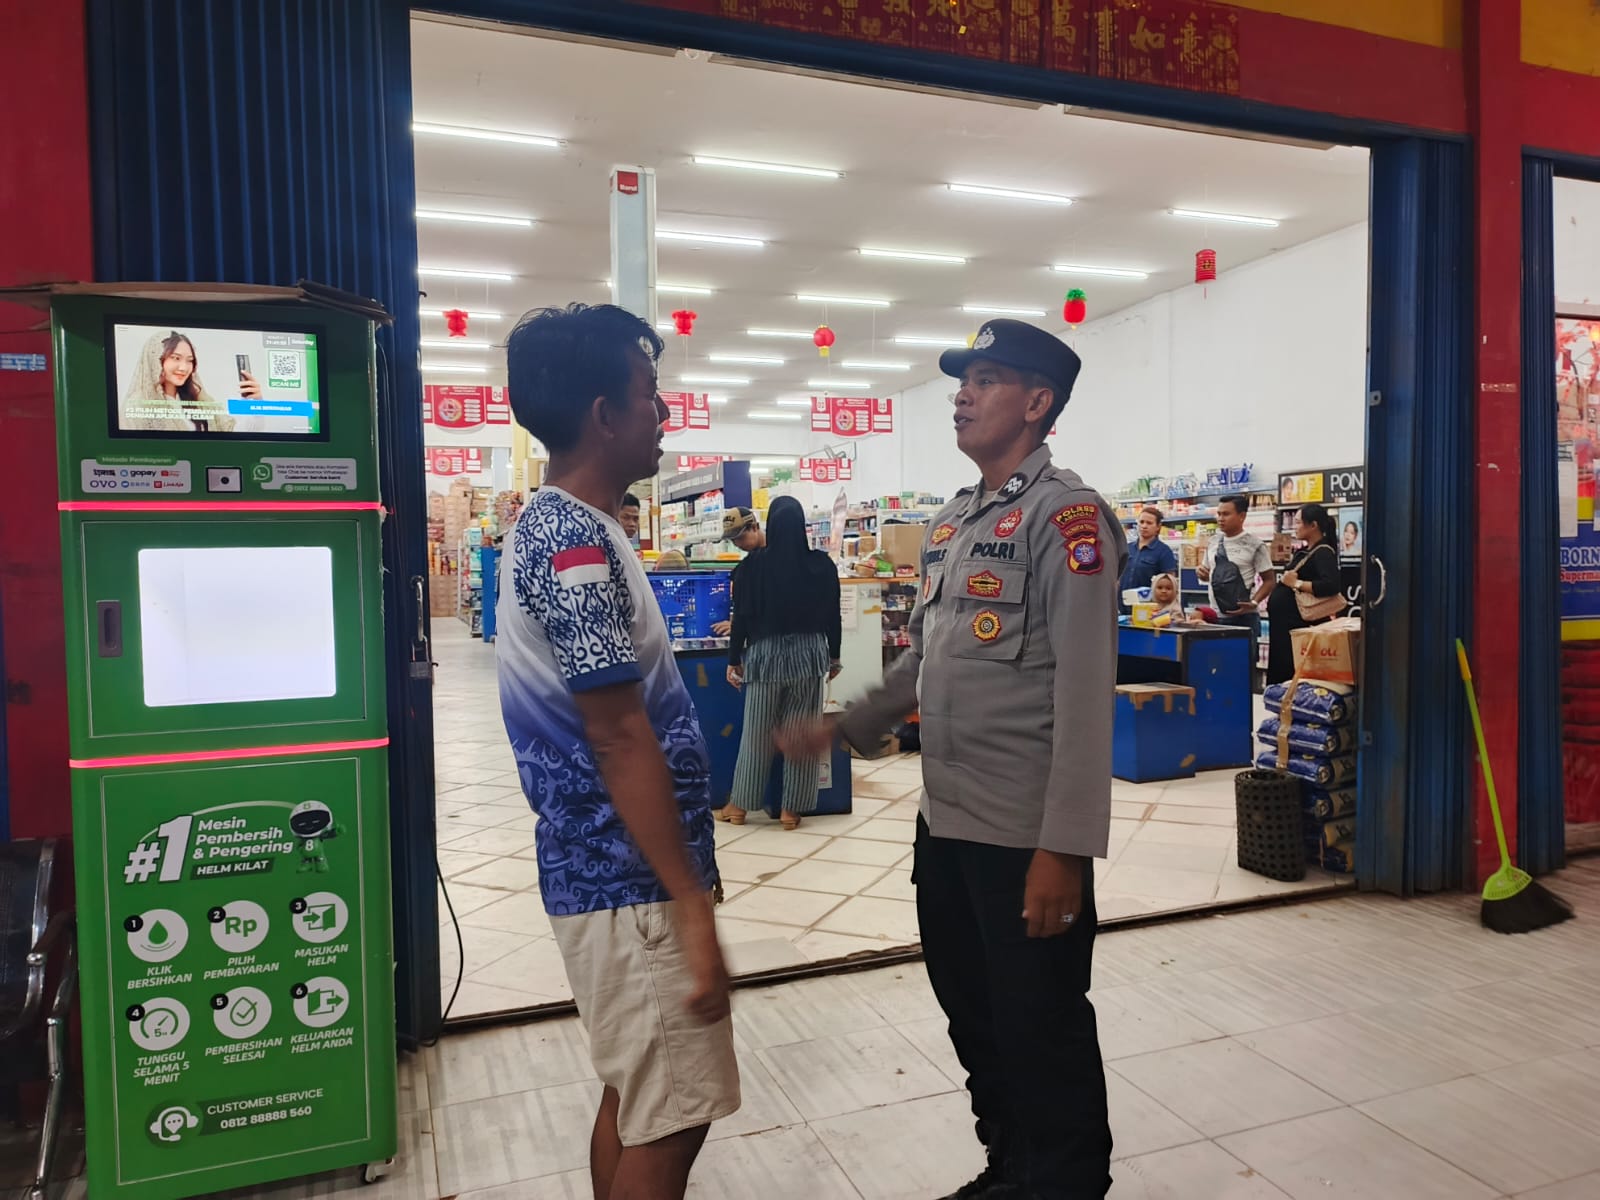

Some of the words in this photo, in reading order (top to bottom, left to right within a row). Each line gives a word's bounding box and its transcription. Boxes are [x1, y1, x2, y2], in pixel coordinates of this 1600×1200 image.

[90, 480, 117, 488] OVO
[970, 542, 1016, 559] POLRI
[198, 816, 246, 831] Mesin
[195, 827, 283, 845] Pembersih
[193, 848, 204, 859] &
[209, 840, 293, 858] Pengering
[197, 863, 232, 875] HELM
[234, 860, 269, 872] KILAT
[295, 902, 302, 910] 3
[213, 911, 221, 919] 2
[225, 916, 257, 937] Rp
[294, 944, 349, 958] MASUKAN
[227, 955, 256, 966] PILIH
[307, 955, 337, 967] HELM
[147, 965, 172, 976] KLIK
[203, 962, 280, 980] PEMBAYARAN
[127, 973, 192, 990] BERSIHKAN
[296, 987, 303, 996] 6
[216, 998, 224, 1006] 5
[132, 1009, 140, 1017] 4
[290, 1027, 354, 1044] KELUARKAN
[205, 1037, 283, 1056] PEMBERSIHAN
[291, 1041, 320, 1054] HELM
[322, 1037, 353, 1050] ANDA
[137, 1051, 185, 1067] TUNGGU
[223, 1049, 266, 1064] SELESAI
[133, 1063, 181, 1078] SELAMA
[182, 1061, 190, 1070] 5
[144, 1073, 181, 1087] MENIT
[207, 1096, 273, 1115] CUSTOMER
[276, 1088, 324, 1104] SERVICE
[220, 1116, 248, 1129] 0812
[250, 1110, 287, 1124] 88888
[290, 1106, 312, 1118] 560
